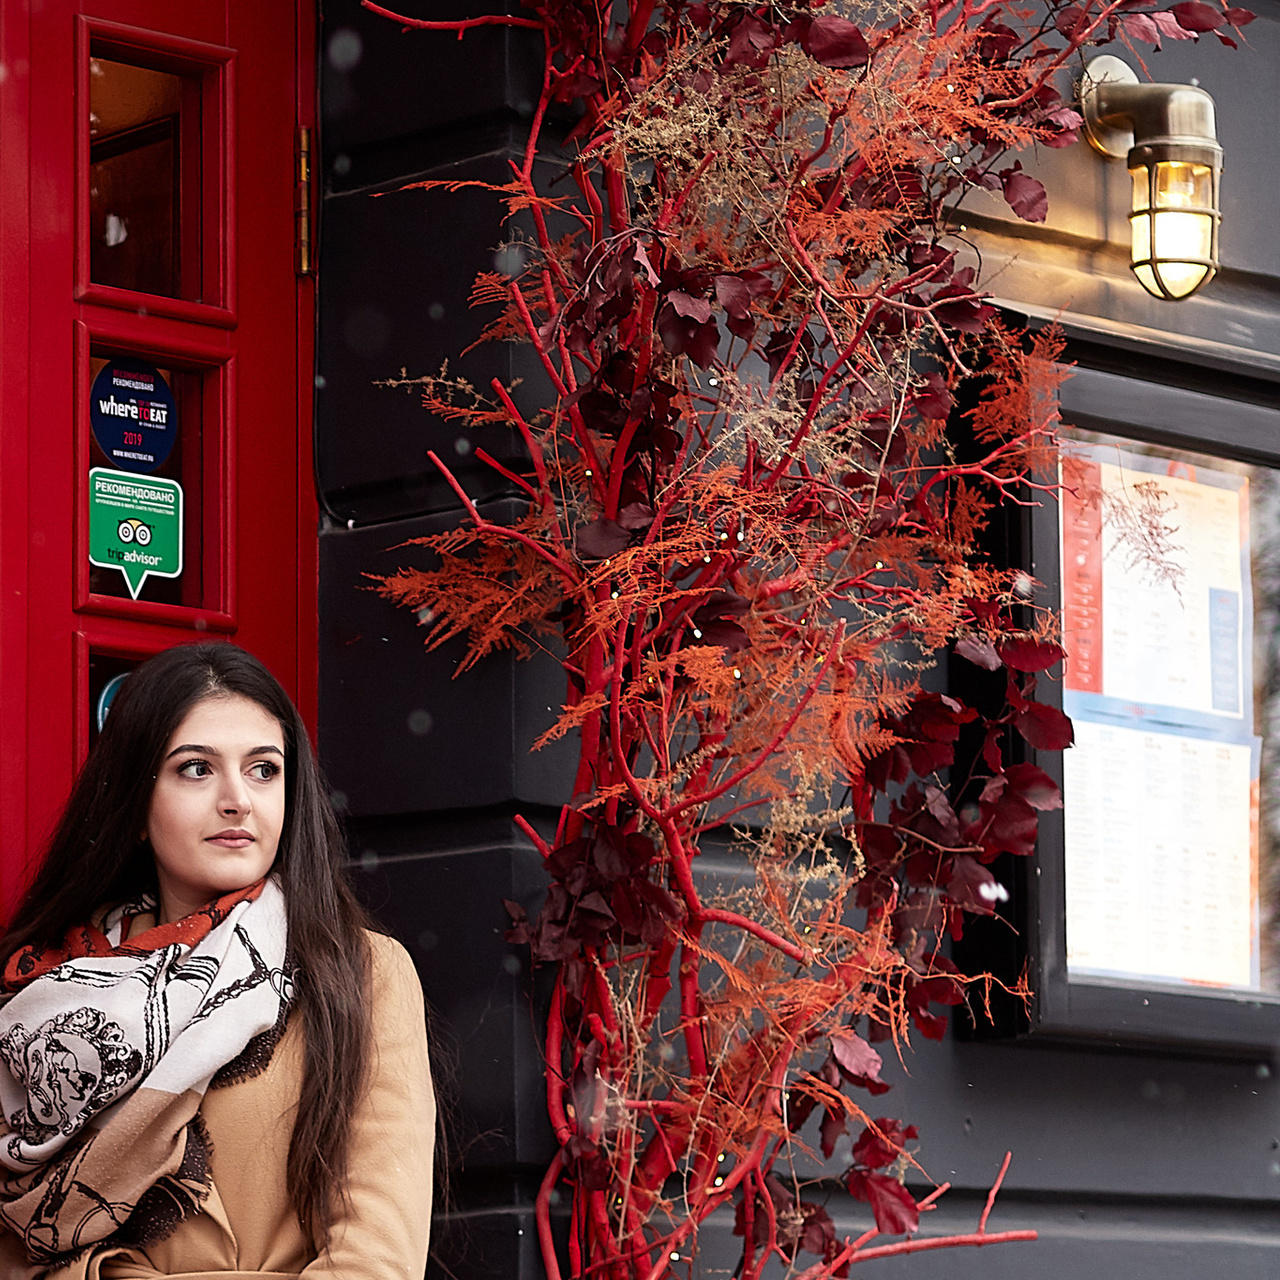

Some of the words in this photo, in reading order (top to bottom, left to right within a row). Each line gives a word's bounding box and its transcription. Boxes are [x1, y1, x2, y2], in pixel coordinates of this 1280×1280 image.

[113, 377, 154, 391] РЕКОМЕНДОВАНО
[123, 431, 142, 446] 2019
[95, 481, 175, 503] РЕКОМЕНДОВАНО
[107, 548, 160, 566] tripadvisor
